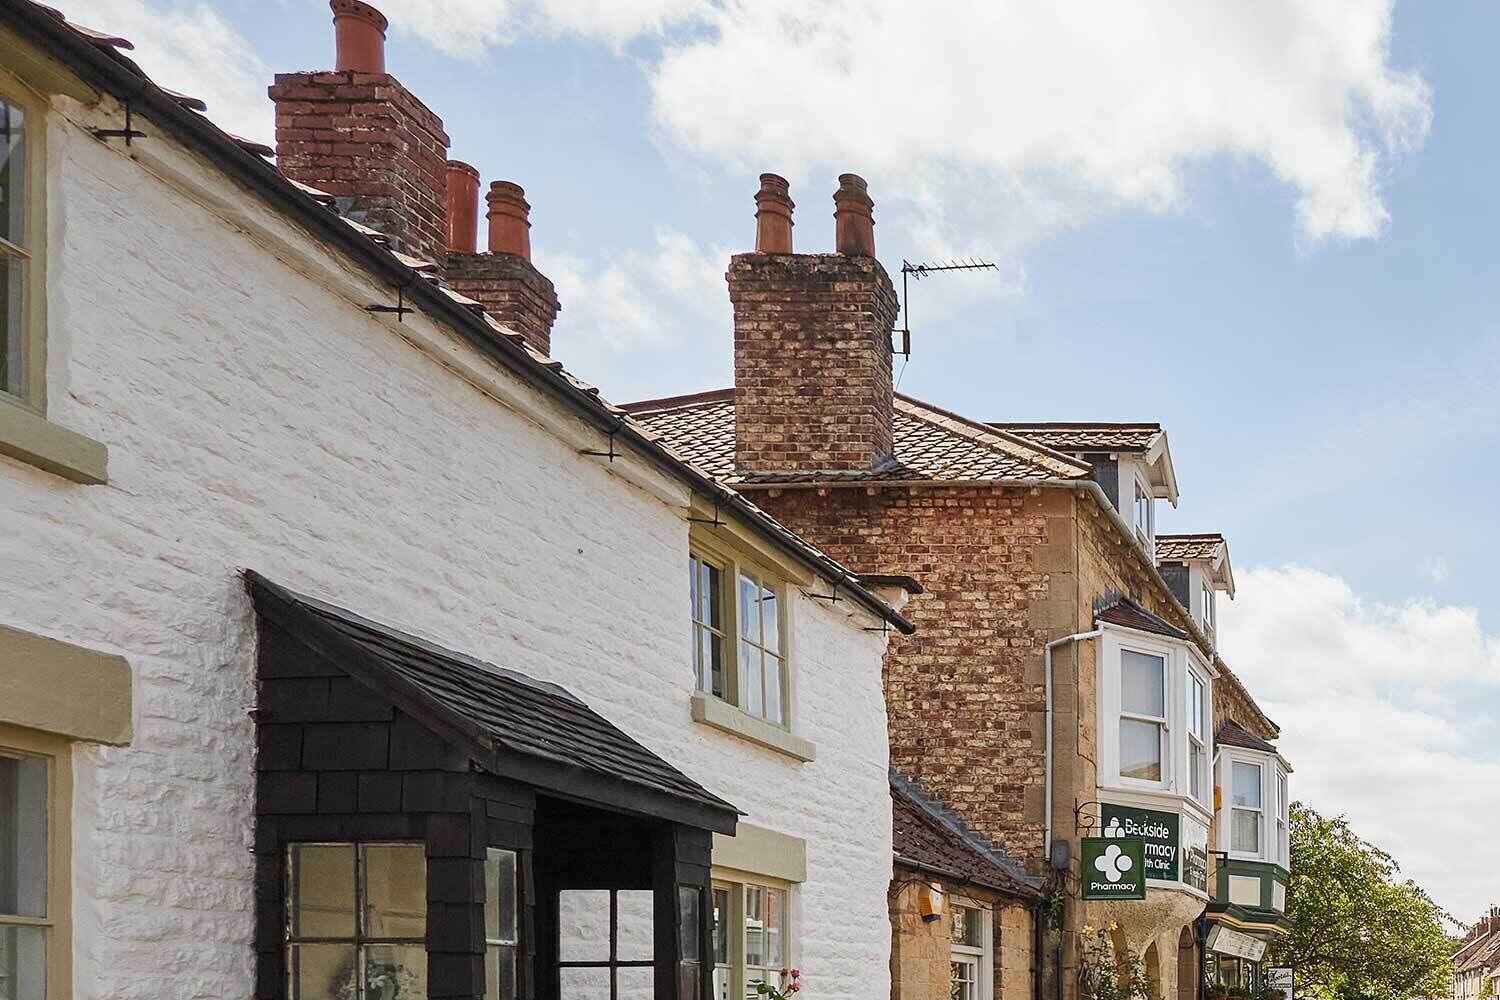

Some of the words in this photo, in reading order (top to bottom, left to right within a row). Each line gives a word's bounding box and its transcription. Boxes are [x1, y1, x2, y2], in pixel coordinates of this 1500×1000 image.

[1125, 818, 1169, 839] Beckside
[1144, 842, 1177, 862] rmacy
[1155, 858, 1170, 870] Clinic
[1091, 882, 1136, 892] Pharmacy
